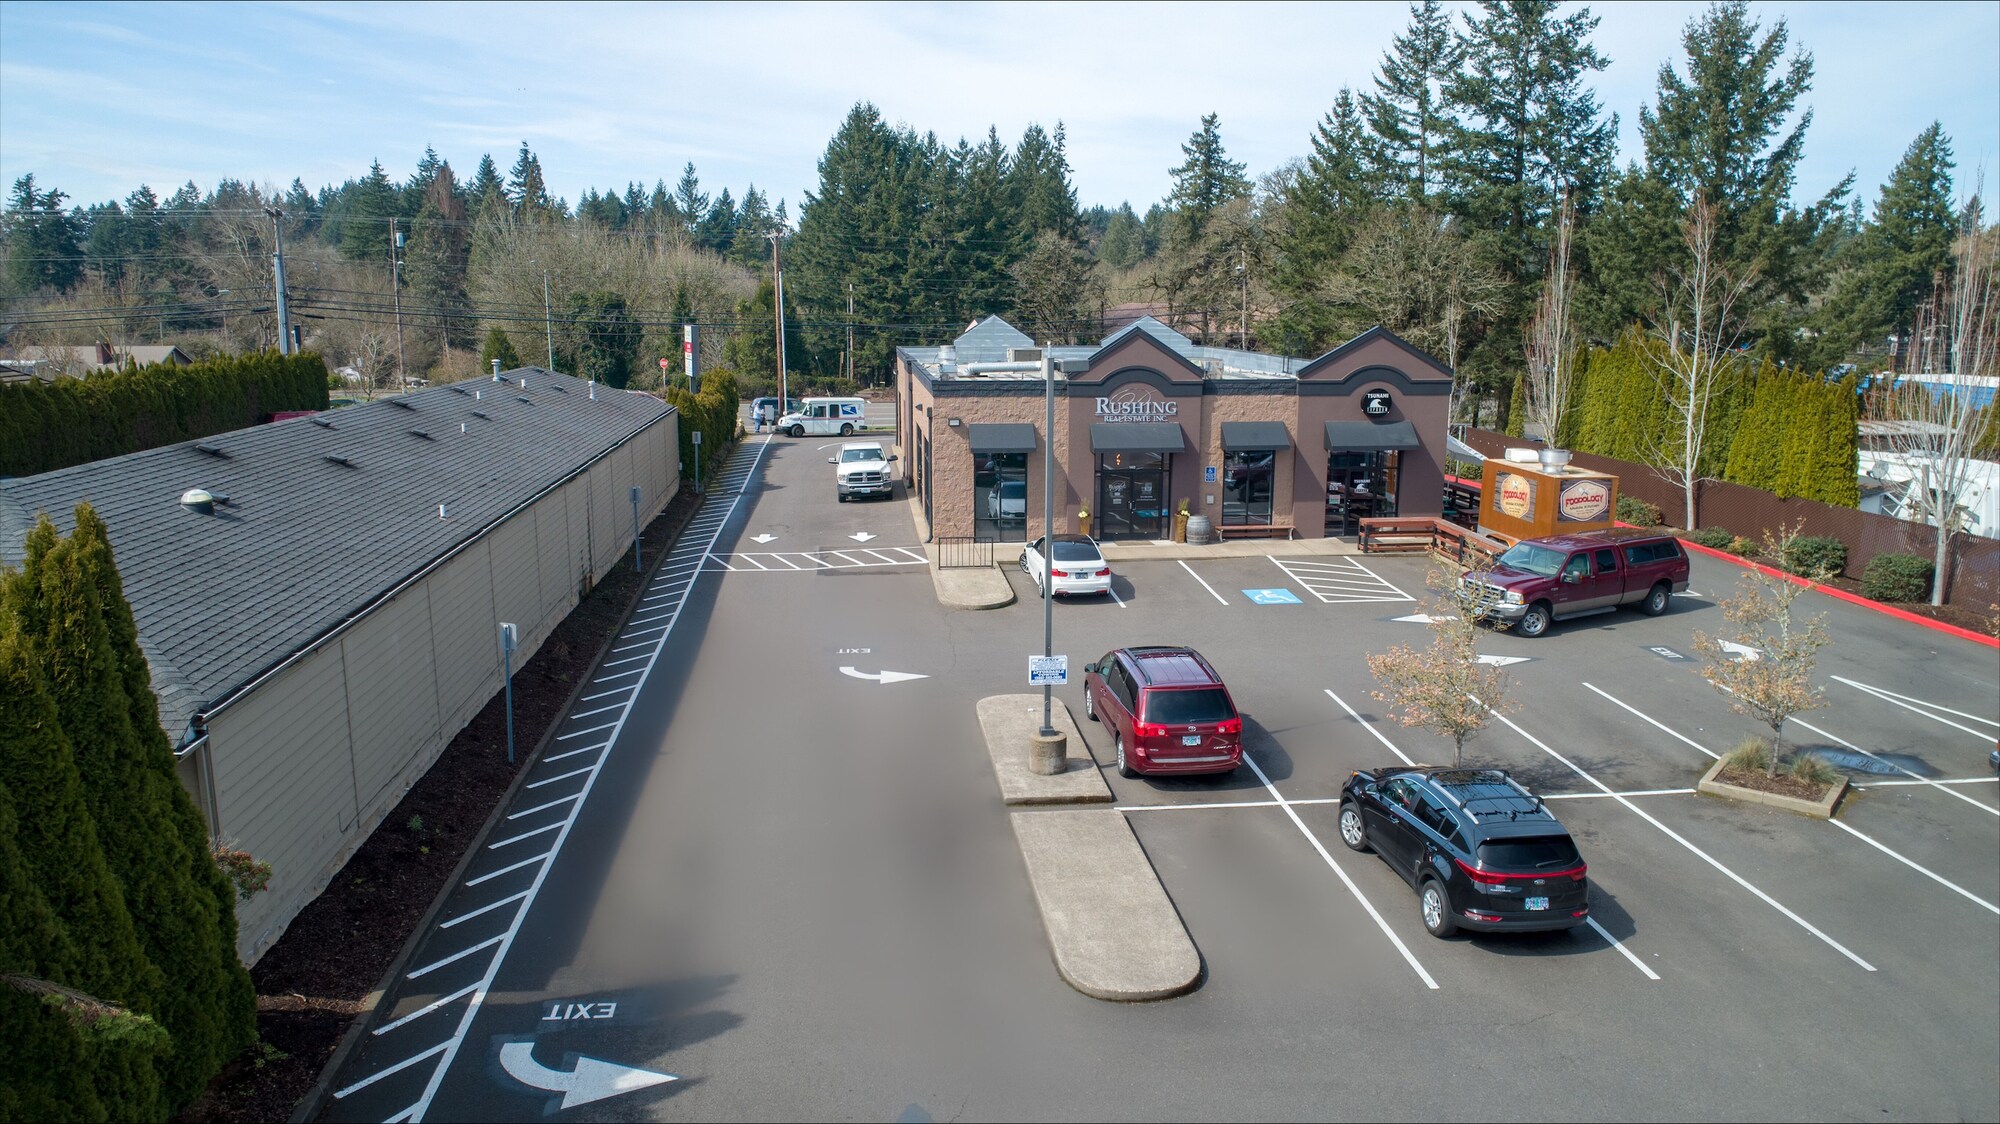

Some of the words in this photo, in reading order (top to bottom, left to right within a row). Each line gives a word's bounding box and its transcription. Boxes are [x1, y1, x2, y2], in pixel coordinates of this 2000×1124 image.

[1095, 397, 1177, 414] RUSHING
[1565, 494, 1604, 507] FOODOLOGY
[1650, 647, 1684, 659] EXIT
[542, 1002, 617, 1021] EXIT
